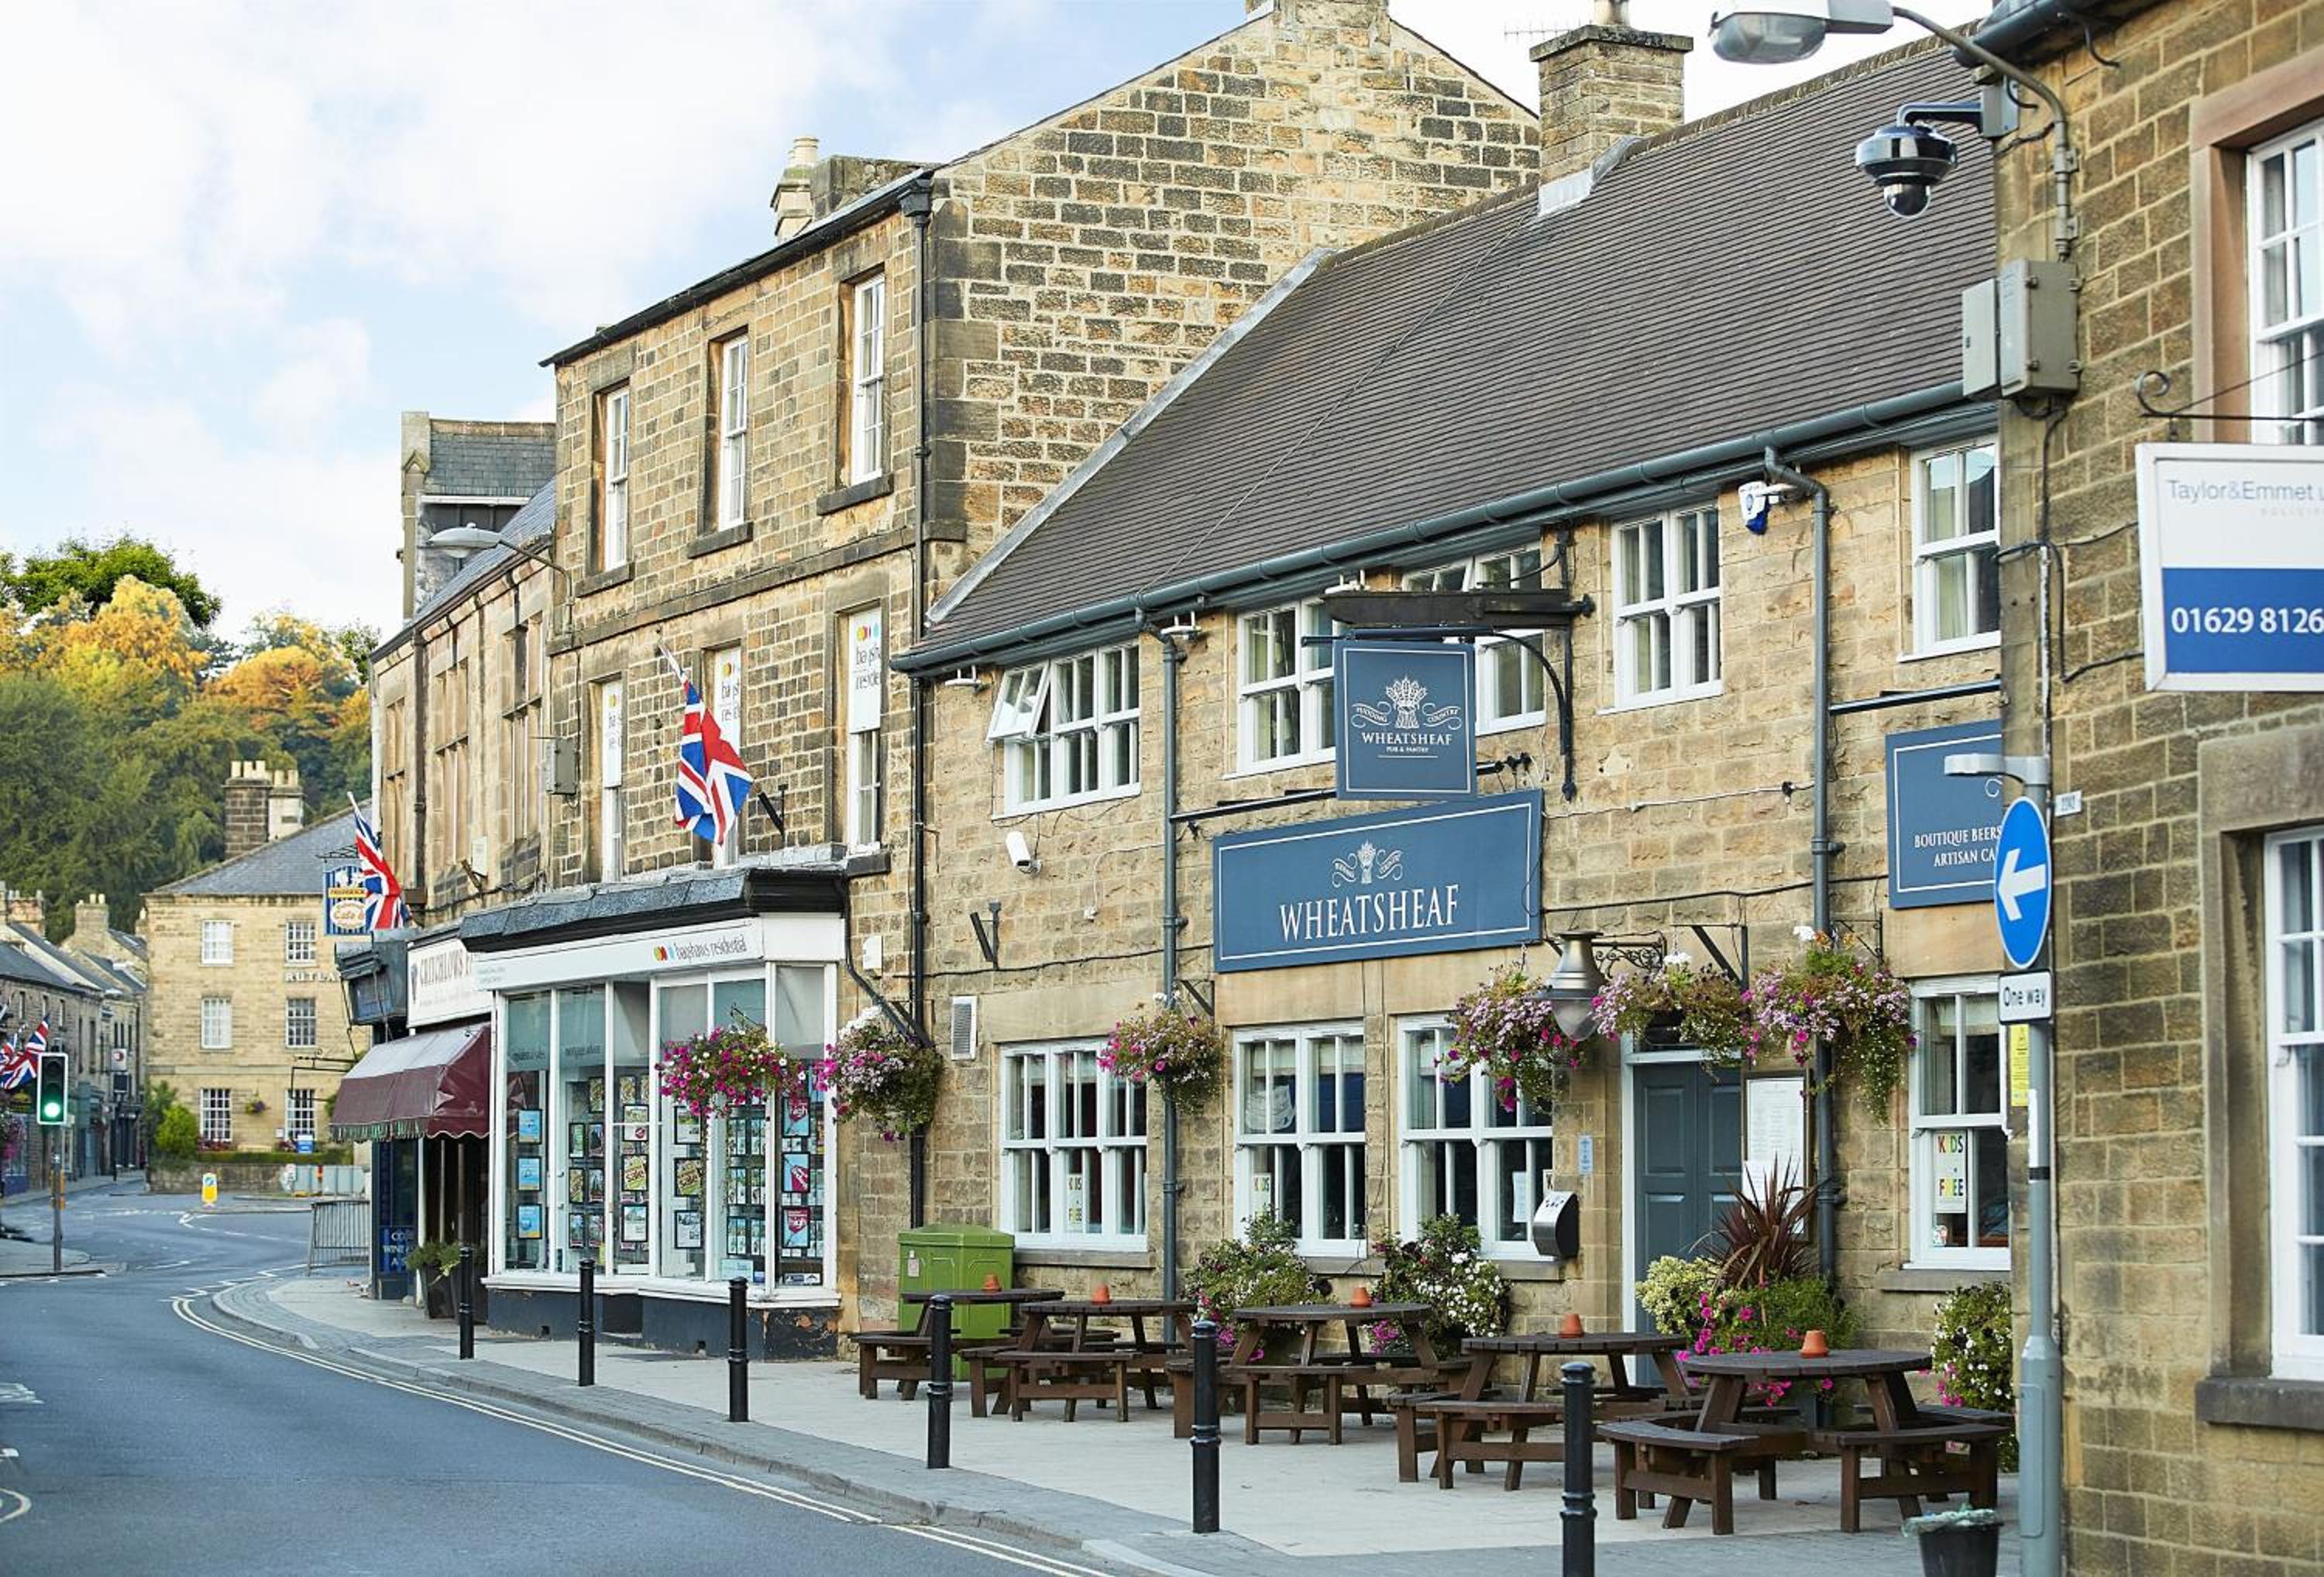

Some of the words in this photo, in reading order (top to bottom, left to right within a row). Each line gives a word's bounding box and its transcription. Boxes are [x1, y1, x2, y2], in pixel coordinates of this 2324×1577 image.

[2166, 479, 2313, 503] Taylor&Emmet
[2171, 607, 2254, 633] 01629
[2260, 607, 2324, 633] 8126
[1361, 732, 1452, 745] WHEATSHEAF
[1914, 830, 1968, 848] BOUTIQUE
[1972, 825, 2002, 842] BEERS
[1934, 849, 1978, 867] ARTISAN
[1279, 883, 1459, 942] WHEATSHEAF
[2003, 986, 2023, 1006] One
[2027, 988, 2046, 1008] way
[1938, 1135, 1964, 1153] KIDS
[1939, 1178, 1964, 1197] FREE
